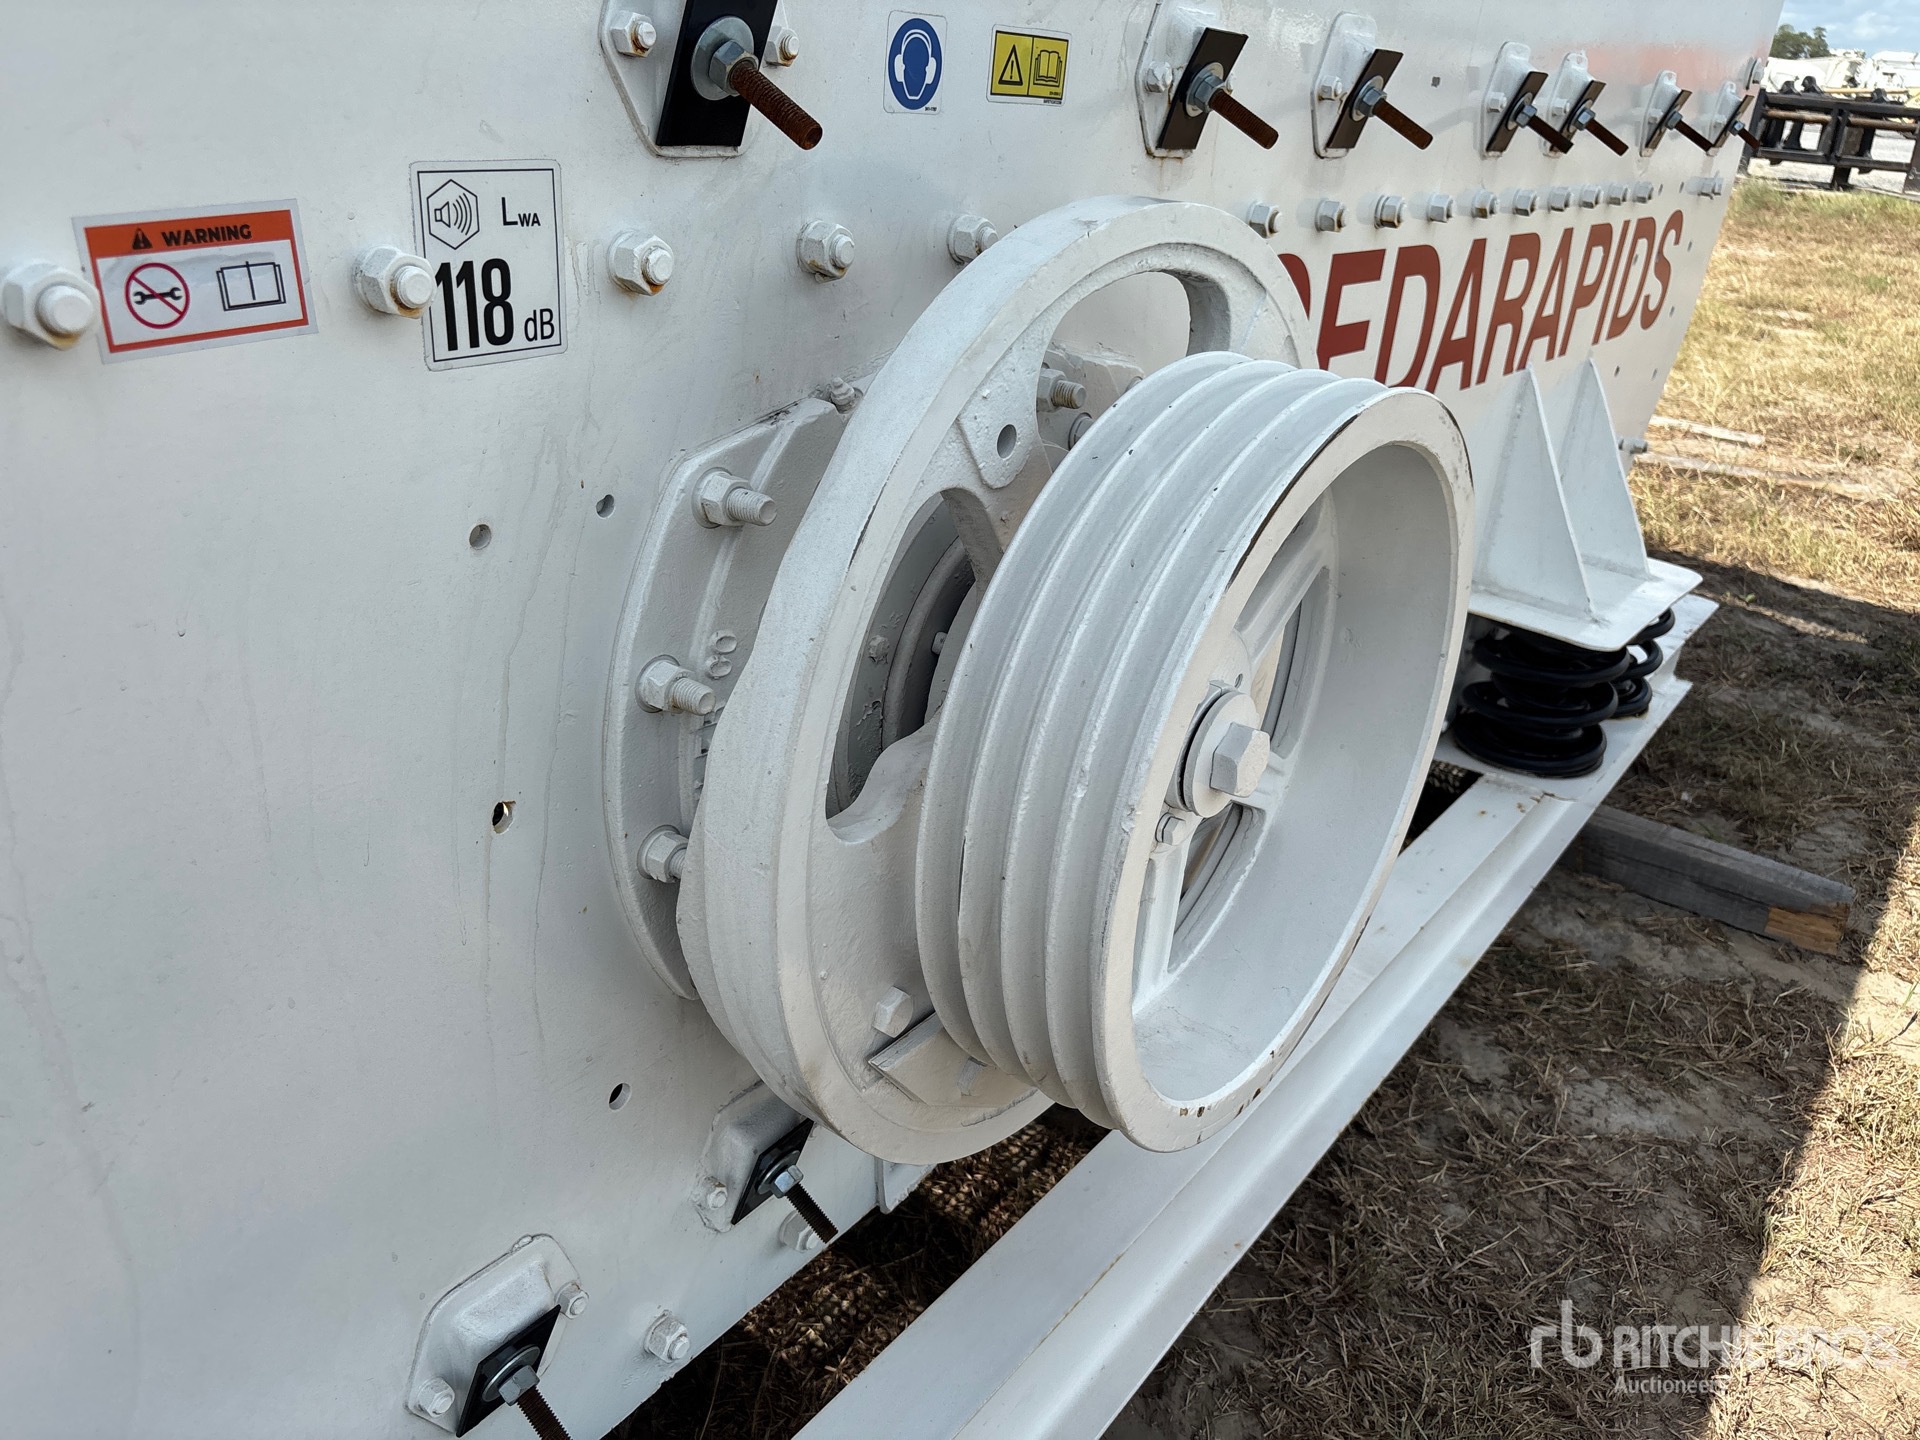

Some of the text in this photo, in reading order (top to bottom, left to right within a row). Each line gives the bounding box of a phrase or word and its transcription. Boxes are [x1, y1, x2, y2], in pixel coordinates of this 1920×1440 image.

[162, 222, 252, 247] WARNING
[435, 258, 555, 351] 118 dB
[1278, 210, 1683, 393] EDARAPIDS
